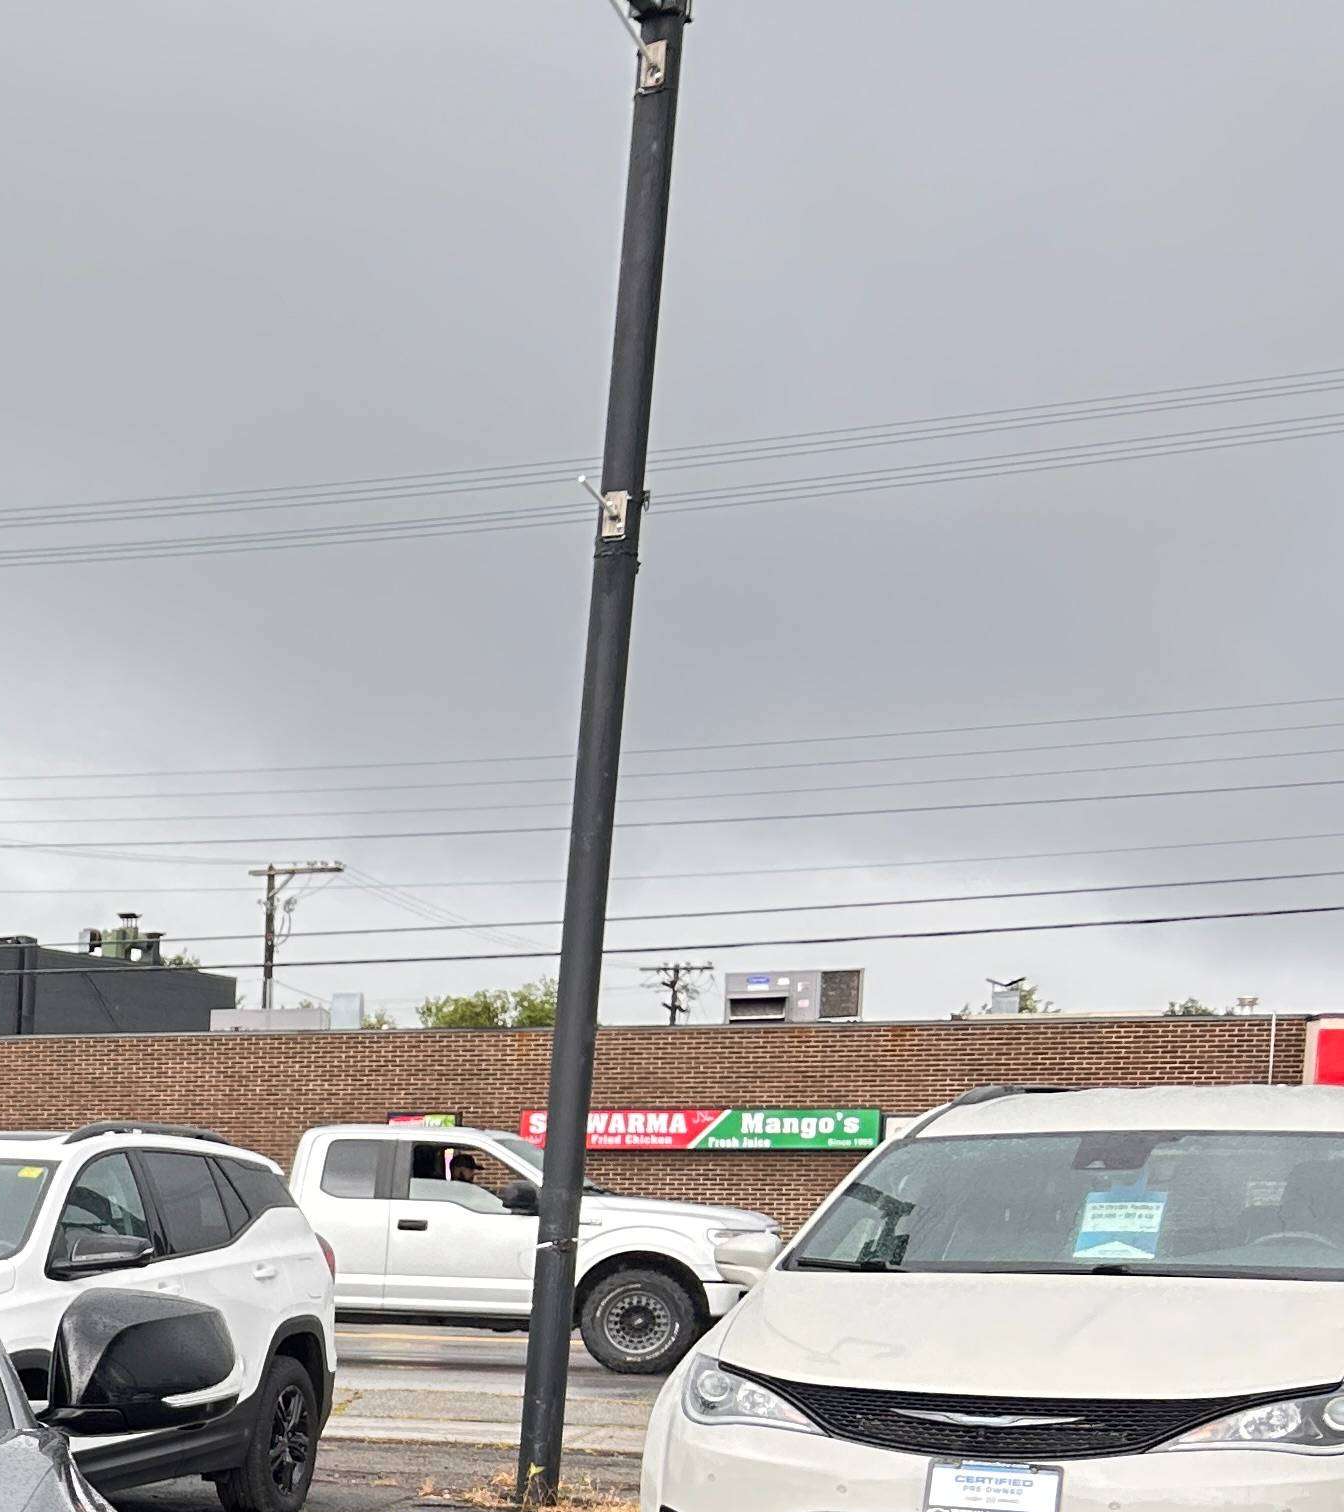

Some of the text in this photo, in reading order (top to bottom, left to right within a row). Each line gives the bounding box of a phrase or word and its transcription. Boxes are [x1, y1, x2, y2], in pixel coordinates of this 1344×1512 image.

[529, 1112, 688, 1134] SWARMA
[740, 1111, 860, 1139] Mango's
[955, 1474, 1033, 1487] CERTIFIED
